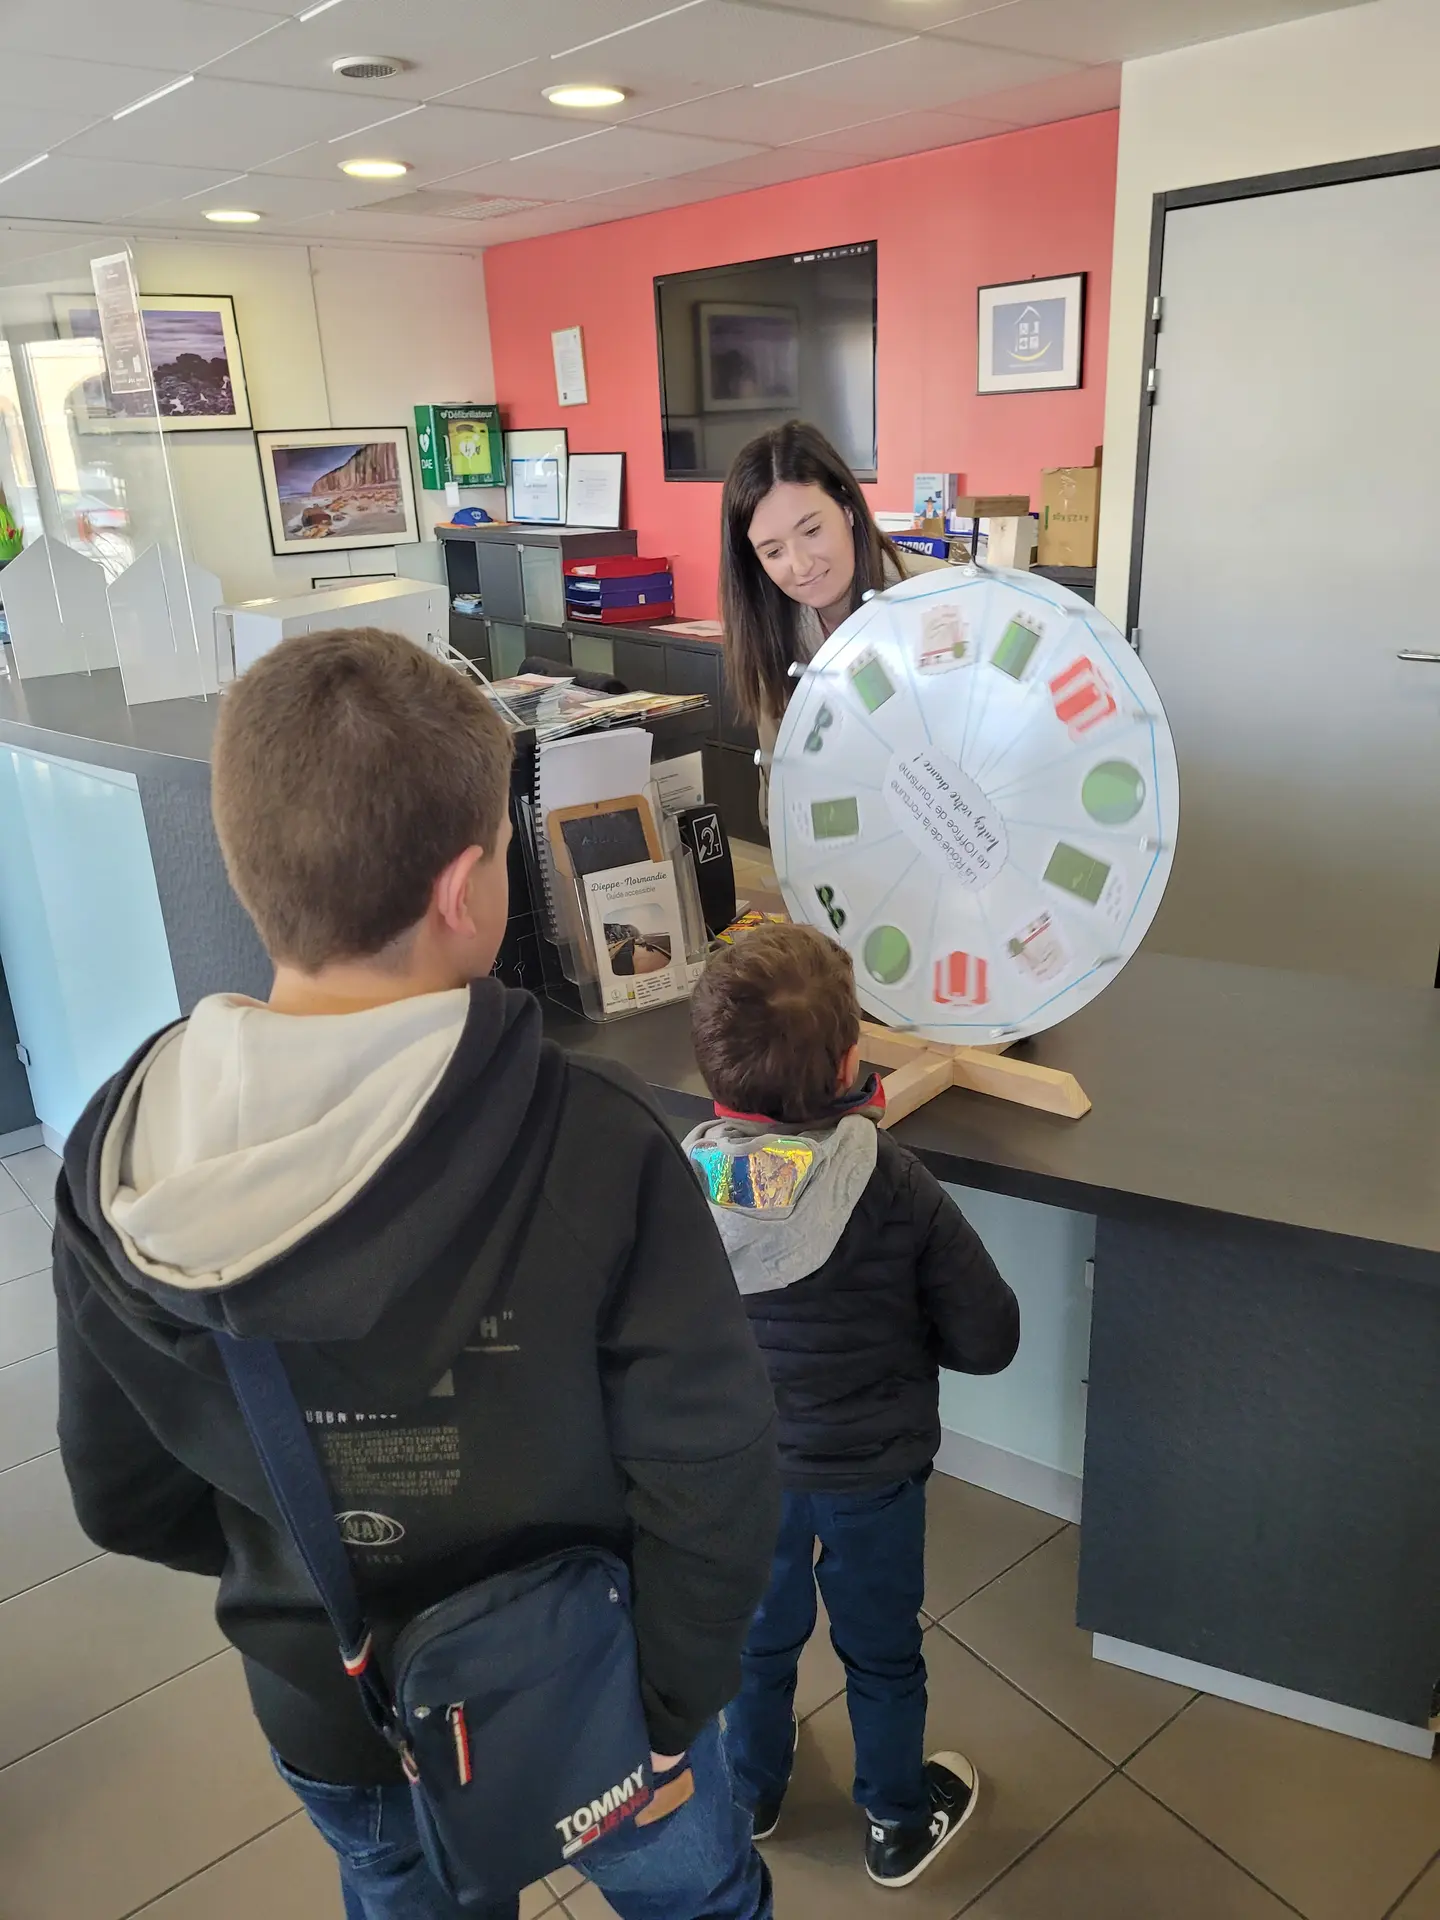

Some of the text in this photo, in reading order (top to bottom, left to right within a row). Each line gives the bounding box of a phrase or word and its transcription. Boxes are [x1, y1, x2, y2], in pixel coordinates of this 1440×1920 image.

[421, 459, 433, 469] DAE
[923, 760, 950, 790] chance
[890, 780, 923, 820] Fortune
[950, 791, 972, 818] votre
[898, 762, 990, 870] de l'Office de Tourisme
[923, 816, 931, 831] la
[930, 827, 943, 841] de
[943, 841, 966, 870] Roue
[591, 872, 667, 892] Dieppe-Normandie
[606, 885, 656, 901] Guide accessible
[555, 1763, 644, 1843] TOMMY
